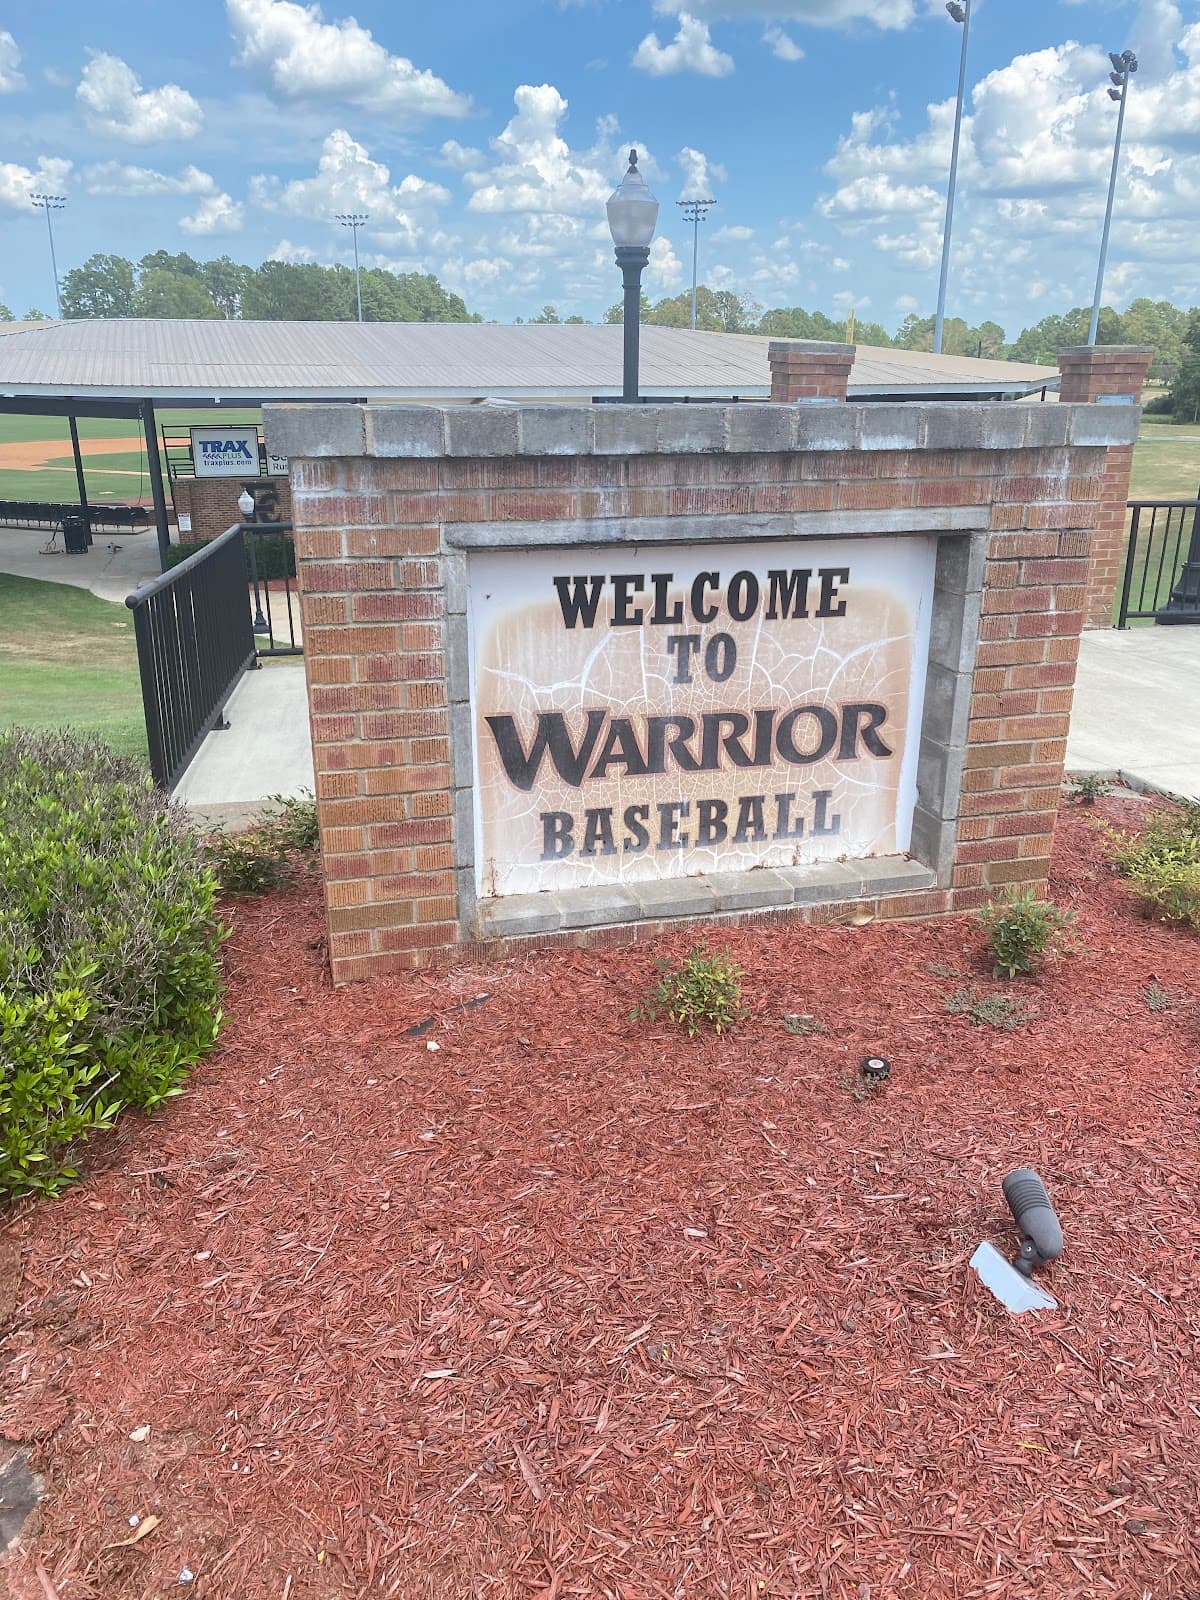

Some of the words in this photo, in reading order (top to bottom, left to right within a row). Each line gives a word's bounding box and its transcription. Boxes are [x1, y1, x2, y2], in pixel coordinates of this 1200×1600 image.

[199, 440, 253, 459] TRAX
[204, 459, 252, 467] traxplus.com
[553, 568, 850, 629] WELCOME
[667, 632, 737, 685] TO
[484, 702, 895, 791] WARRIOR
[539, 790, 841, 861] BASEBALL
